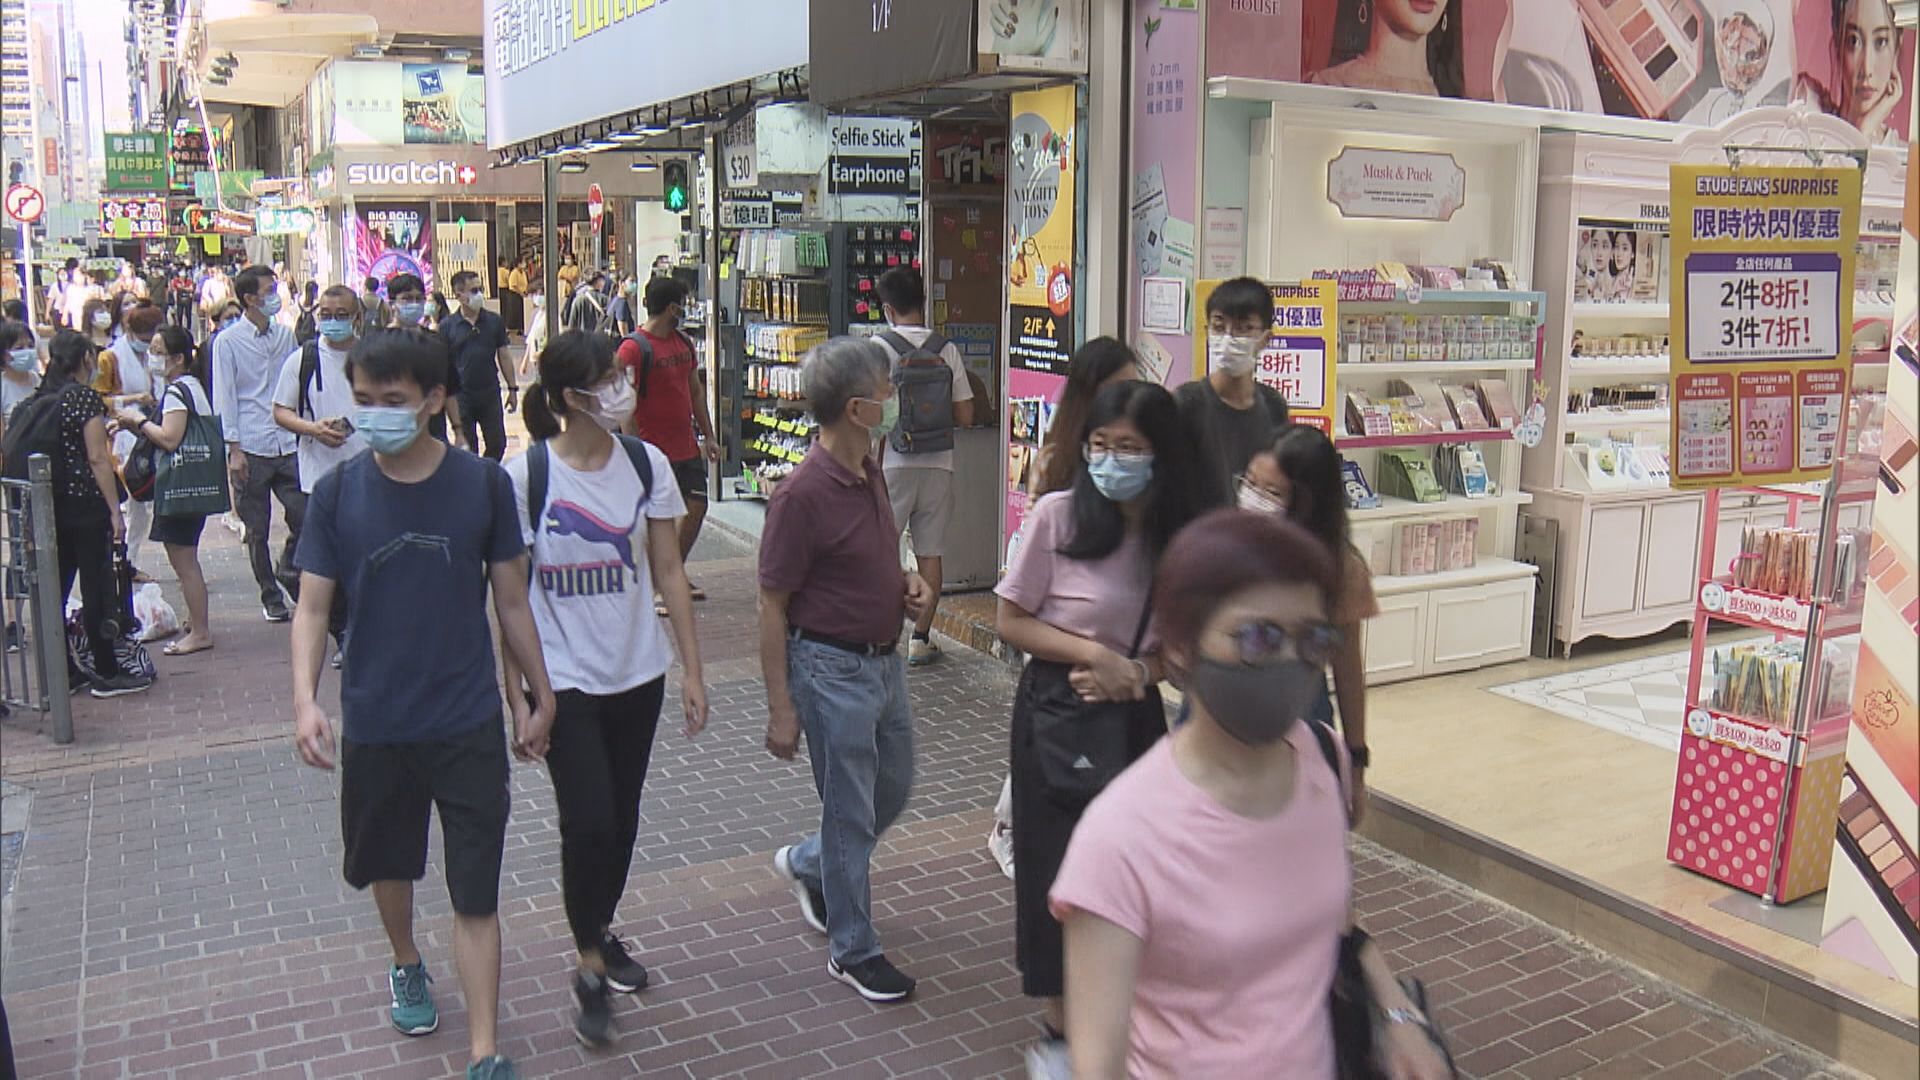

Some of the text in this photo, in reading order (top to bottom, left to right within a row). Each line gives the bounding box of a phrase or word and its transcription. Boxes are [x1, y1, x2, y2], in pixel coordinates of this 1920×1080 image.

[1150, 63, 1180, 76] 0.2mm
[831, 126, 906, 148] Selfie Stick
[348, 160, 457, 185] swatch
[730, 154, 751, 183] $30
[831, 163, 906, 187] Earphone
[1363, 164, 1433, 182] Mask & Pack
[1014, 186, 1059, 202] NAUGHTY
[1696, 176, 1838, 197] ETUDE FANS SURPRISE
[368, 211, 418, 220] BIG BOLD
[1023, 204, 1050, 219] TOYS
[1692, 207, 1841, 240] 限時快閃優惠
[1023, 317, 1043, 336] 2/F
[540, 560, 625, 598] PUMA
